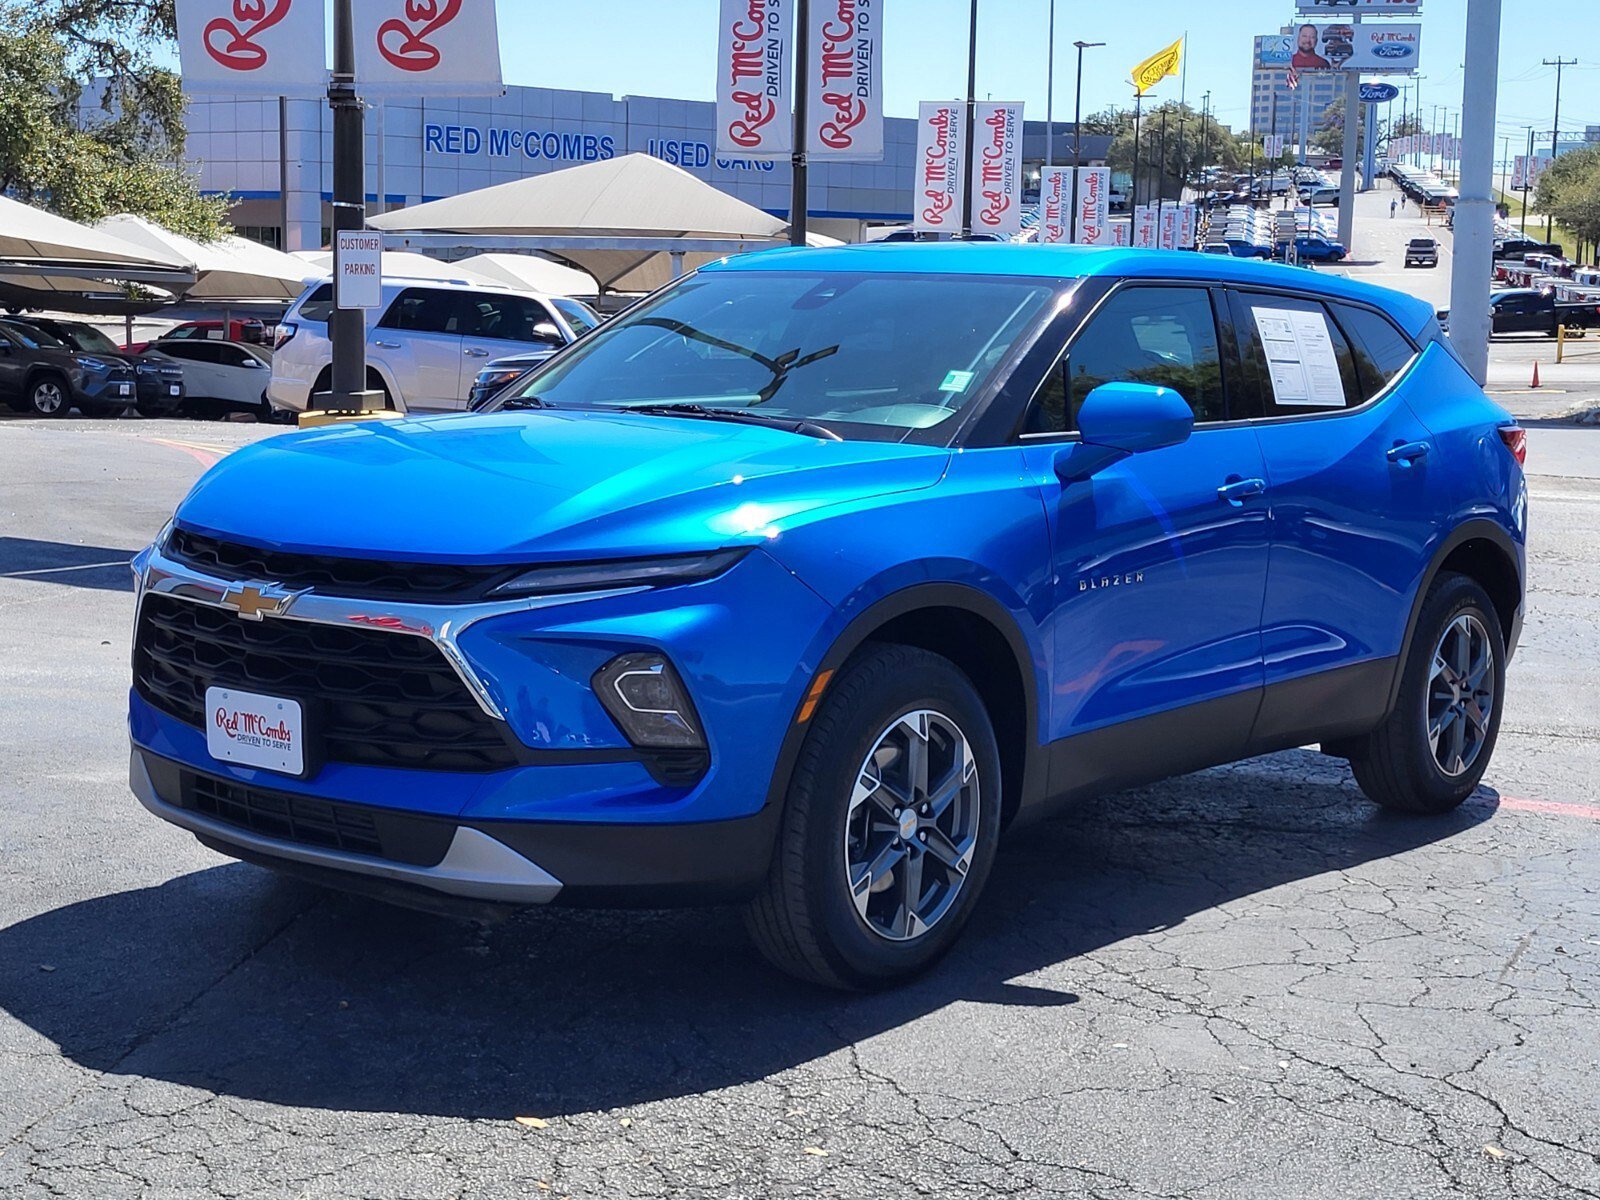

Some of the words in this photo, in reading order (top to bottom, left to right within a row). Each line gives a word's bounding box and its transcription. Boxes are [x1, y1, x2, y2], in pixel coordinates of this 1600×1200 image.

[768, 12, 780, 33] TO
[858, 12, 870, 34] TO
[766, 38, 779, 97] DRIVEN
[857, 38, 869, 97] DRIVEN
[1379, 46, 1406, 56] Ford
[1359, 86, 1388, 99] Ford
[729, 91, 776, 147] Red
[819, 92, 866, 149] Red
[950, 108, 958, 139] SERVE
[1006, 108, 1015, 139] SERVE
[424, 124, 482, 156] RED
[648, 139, 710, 168] USED
[925, 108, 949, 187] McCombs
[949, 141, 957, 154] TO
[982, 108, 1006, 187] McCombs
[1005, 141, 1014, 154] TO
[947, 157, 956, 194] DRIVEN
[1004, 157, 1013, 194] DRIVEN
[922, 190, 953, 225] Red
[980, 190, 1010, 225] Red
[1046, 171, 1062, 222] McCombs
[1083, 172, 1098, 222] McCombs
[340, 238, 379, 250] CUSTOMER
[344, 263, 376, 275] PARKING
[1079, 571, 1144, 591] BLAZER
[216, 707, 239, 738] Red
[240, 712, 291, 741] McCombs
[237, 733, 261, 745] DRIVEN
[262, 739, 271, 747] TO
[272, 740, 291, 751] SERVE
